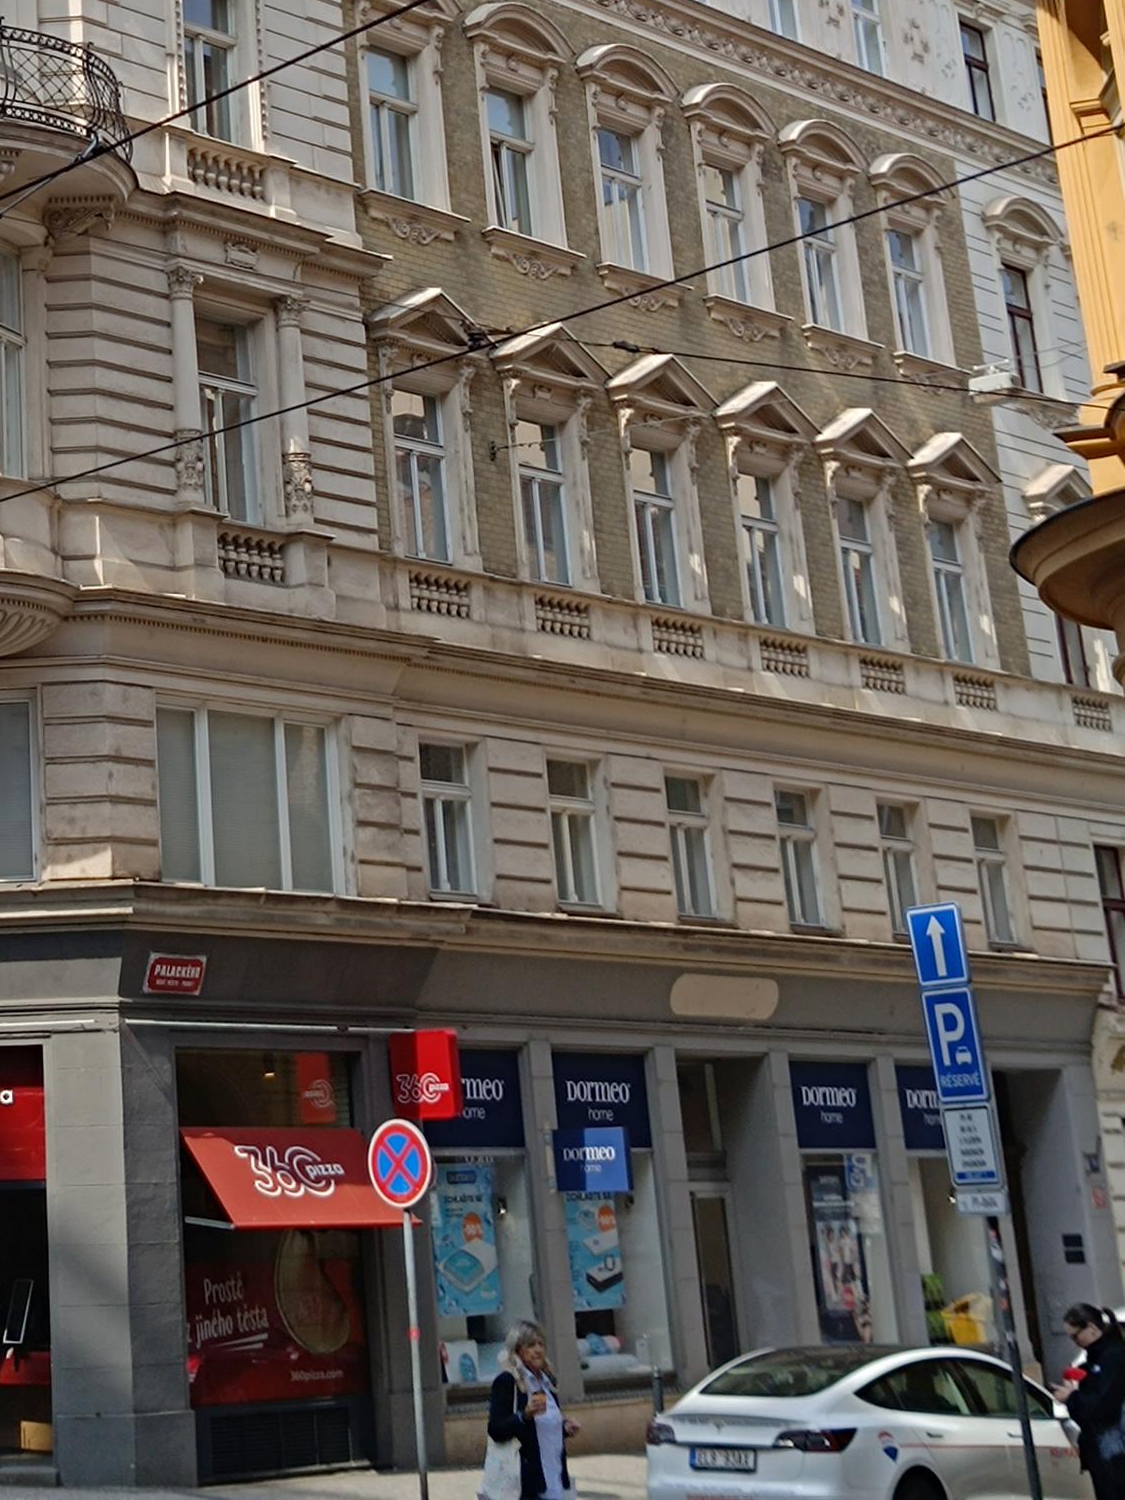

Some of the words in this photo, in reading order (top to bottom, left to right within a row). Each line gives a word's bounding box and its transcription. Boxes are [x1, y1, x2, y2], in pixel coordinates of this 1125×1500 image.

[154, 964, 201, 979] PALACKÉHO
[933, 1002, 966, 1067] P
[396, 1072, 442, 1104] 360
[904, 1088, 940, 1110] Dorm
[462, 1106, 487, 1120] ome
[587, 1106, 615, 1121] home
[820, 1110, 844, 1124] home
[234, 1145, 336, 1197] 360
[305, 1163, 345, 1179] pizza
[195, 1309, 234, 1349] jiného
